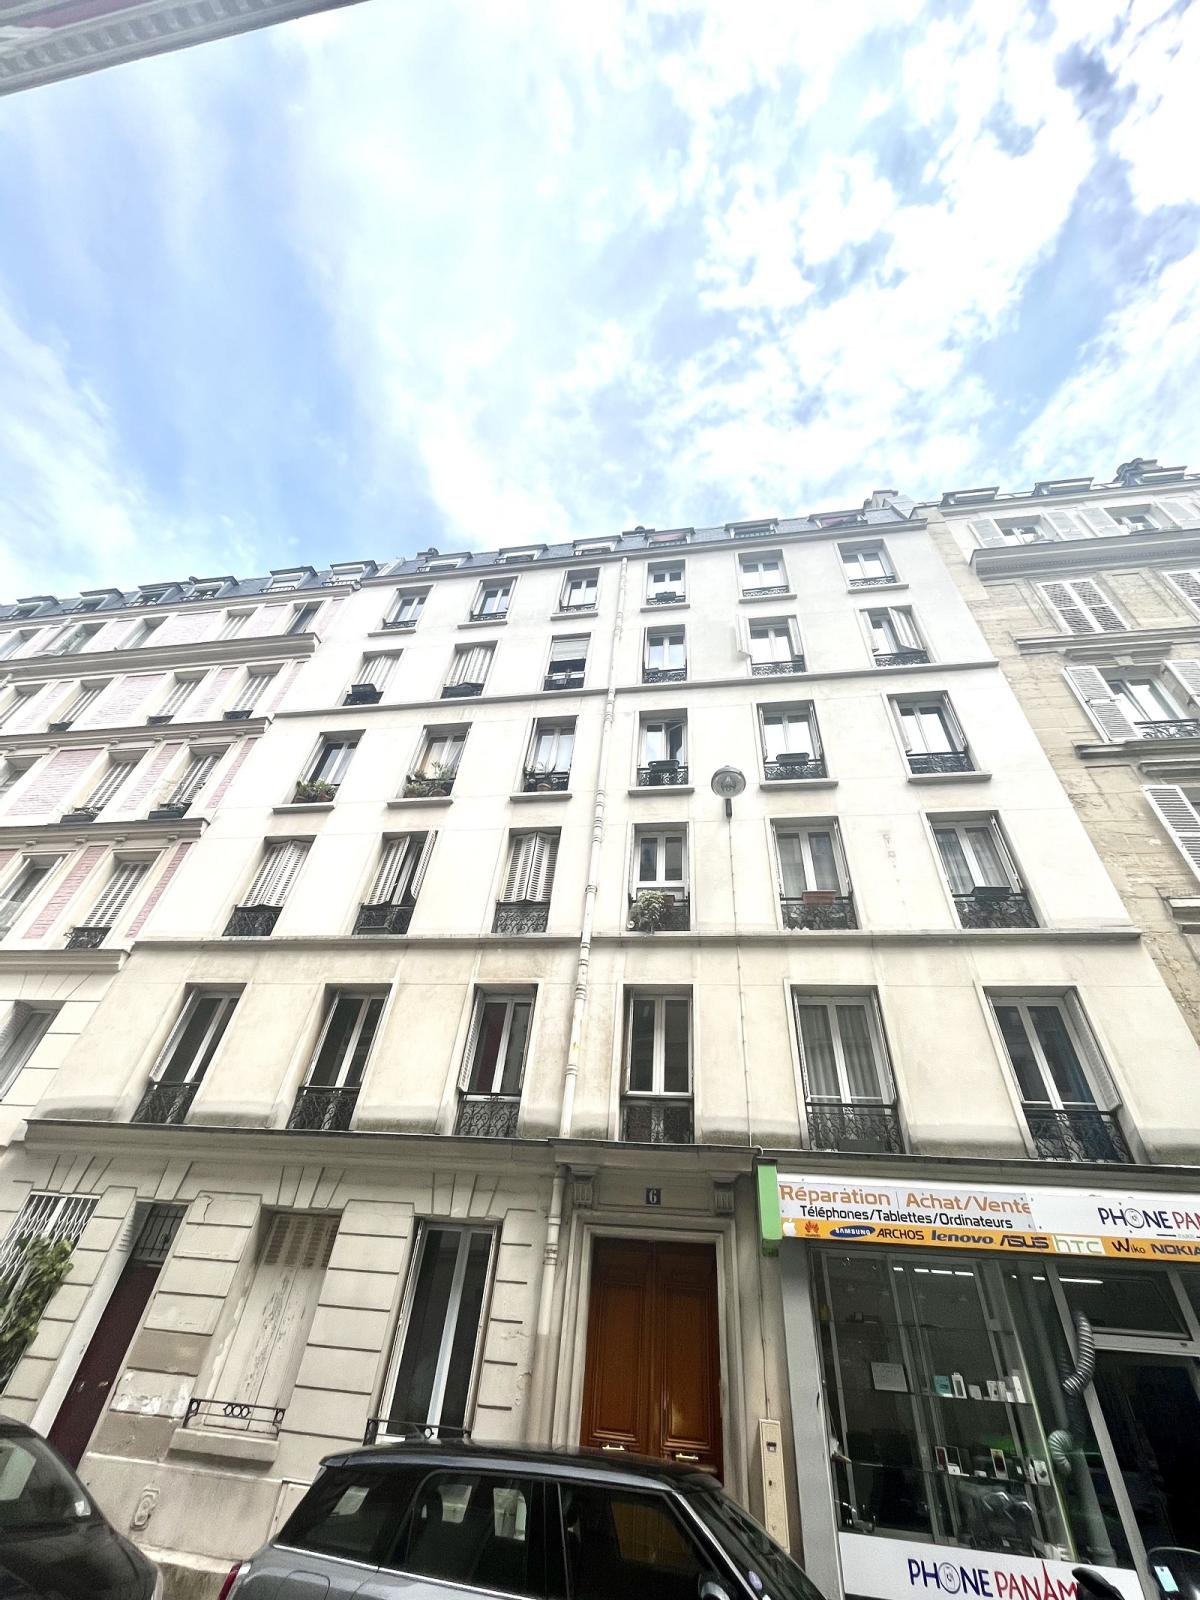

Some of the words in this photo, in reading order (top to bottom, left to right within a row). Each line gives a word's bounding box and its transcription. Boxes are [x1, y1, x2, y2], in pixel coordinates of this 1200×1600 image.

[649, 1189, 657, 1204] 6
[780, 1184, 891, 1206] Réparation
[906, 1192, 1031, 1214] Achat/Vente
[800, 1205, 1013, 1229] Téléphones/Tablettes/Ordinateurs
[835, 1227, 871, 1236] SAMSUNG
[876, 1228, 925, 1240] ARCHOS
[931, 1230, 994, 1245] lenovo
[1000, 1234, 1050, 1249] ASUS
